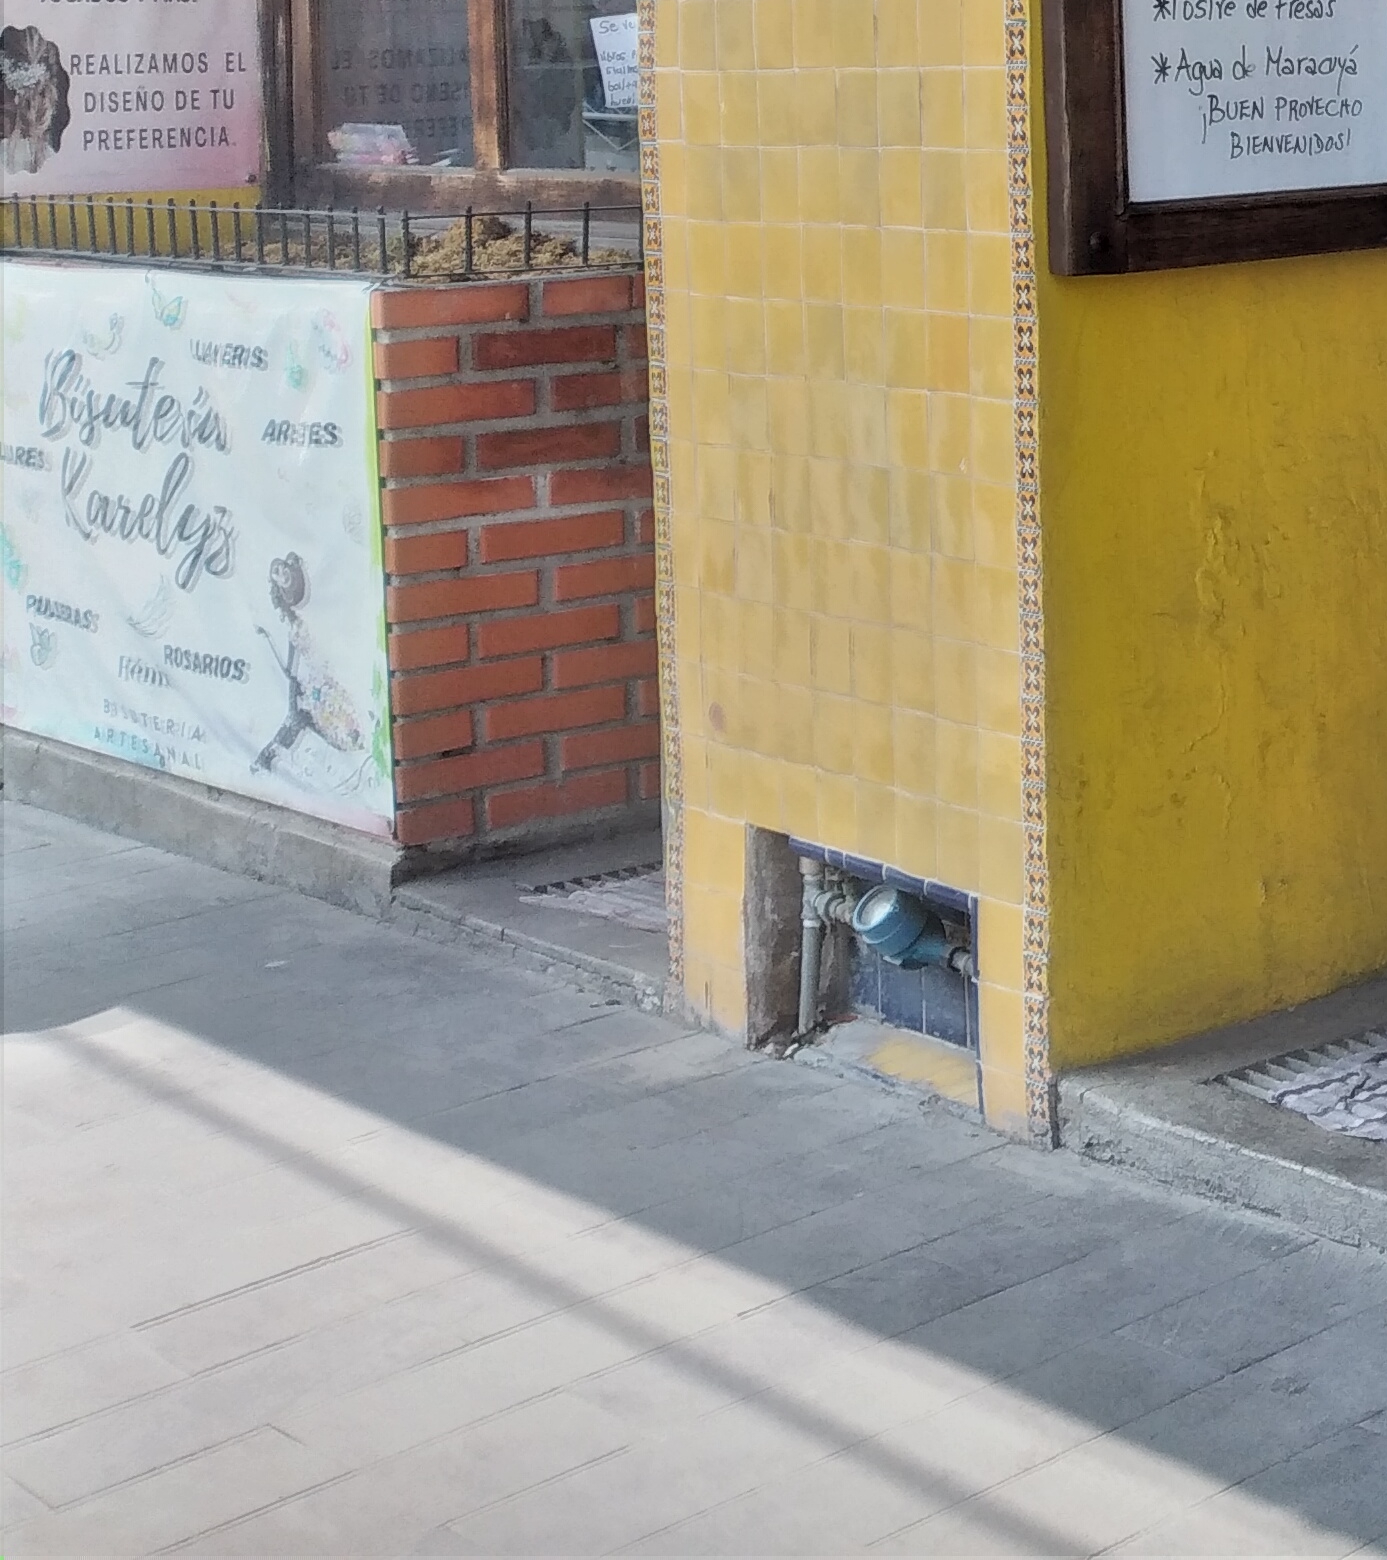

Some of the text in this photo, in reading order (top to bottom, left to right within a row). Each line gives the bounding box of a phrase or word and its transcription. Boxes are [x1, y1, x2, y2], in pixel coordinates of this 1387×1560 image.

[69, 52, 247, 76] REALIZAMOS EL
[1174, 47, 1223, 96] Agua
[1232, 44, 1256, 81] de
[84, 85, 235, 113] DISEÑO DE TU
[1275, 95, 1363, 122] PROVECHO
[164, 645, 247, 682] ROSARIOS
